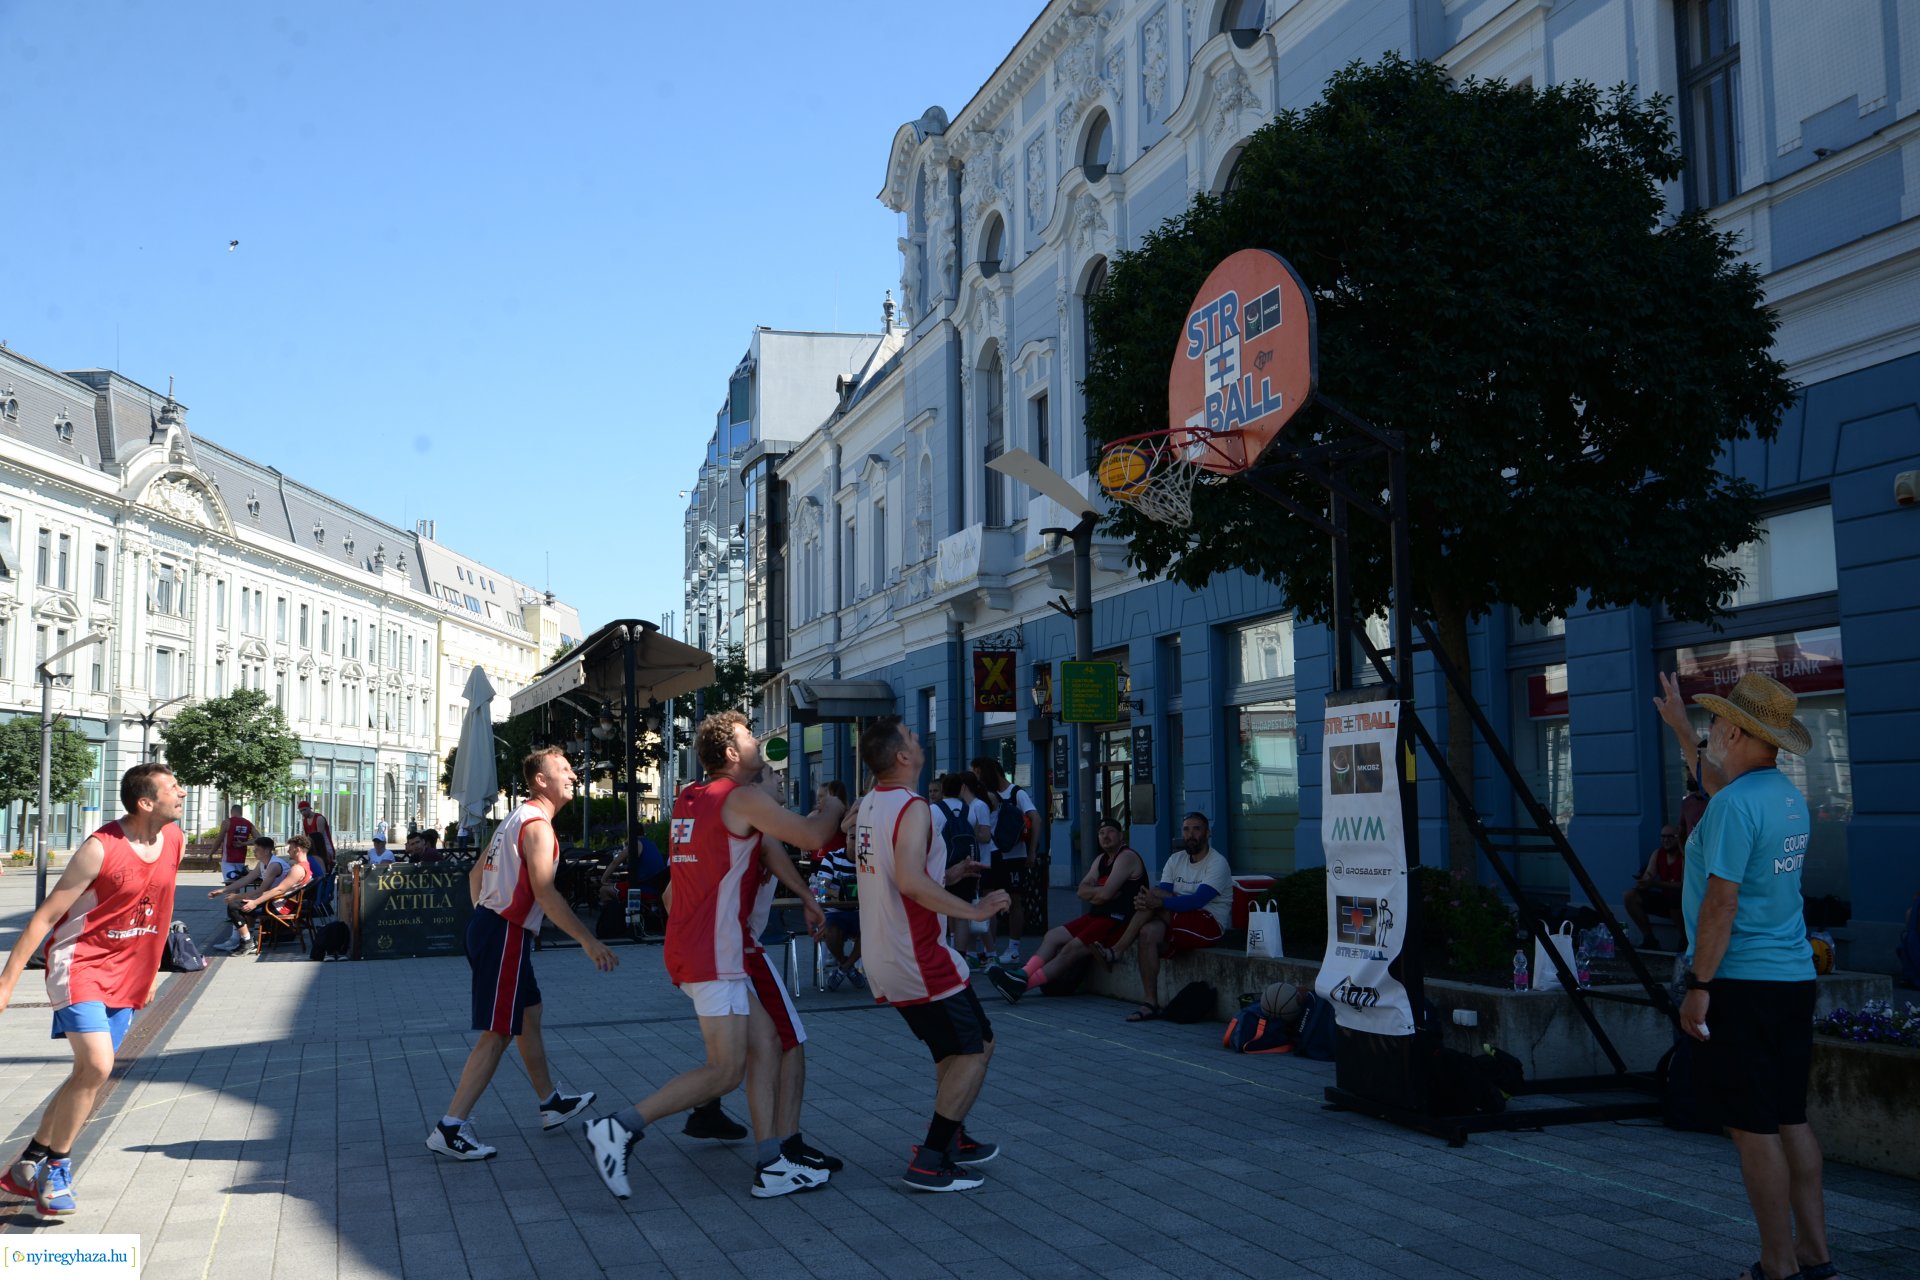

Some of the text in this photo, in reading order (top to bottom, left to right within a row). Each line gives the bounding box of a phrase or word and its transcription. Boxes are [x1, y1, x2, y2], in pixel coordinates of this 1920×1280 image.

[1187, 290, 1240, 360] STR
[1205, 372, 1282, 433] BALL
[980, 656, 1009, 690] X
[1782, 660, 1822, 677] BANK
[1357, 763, 1380, 771] MKOSZ
[1331, 816, 1385, 840] MVM
[378, 869, 453, 891] KÖKÉNY
[1346, 867, 1393, 876] GROSBASKET
[384, 893, 454, 911] ATTILA
